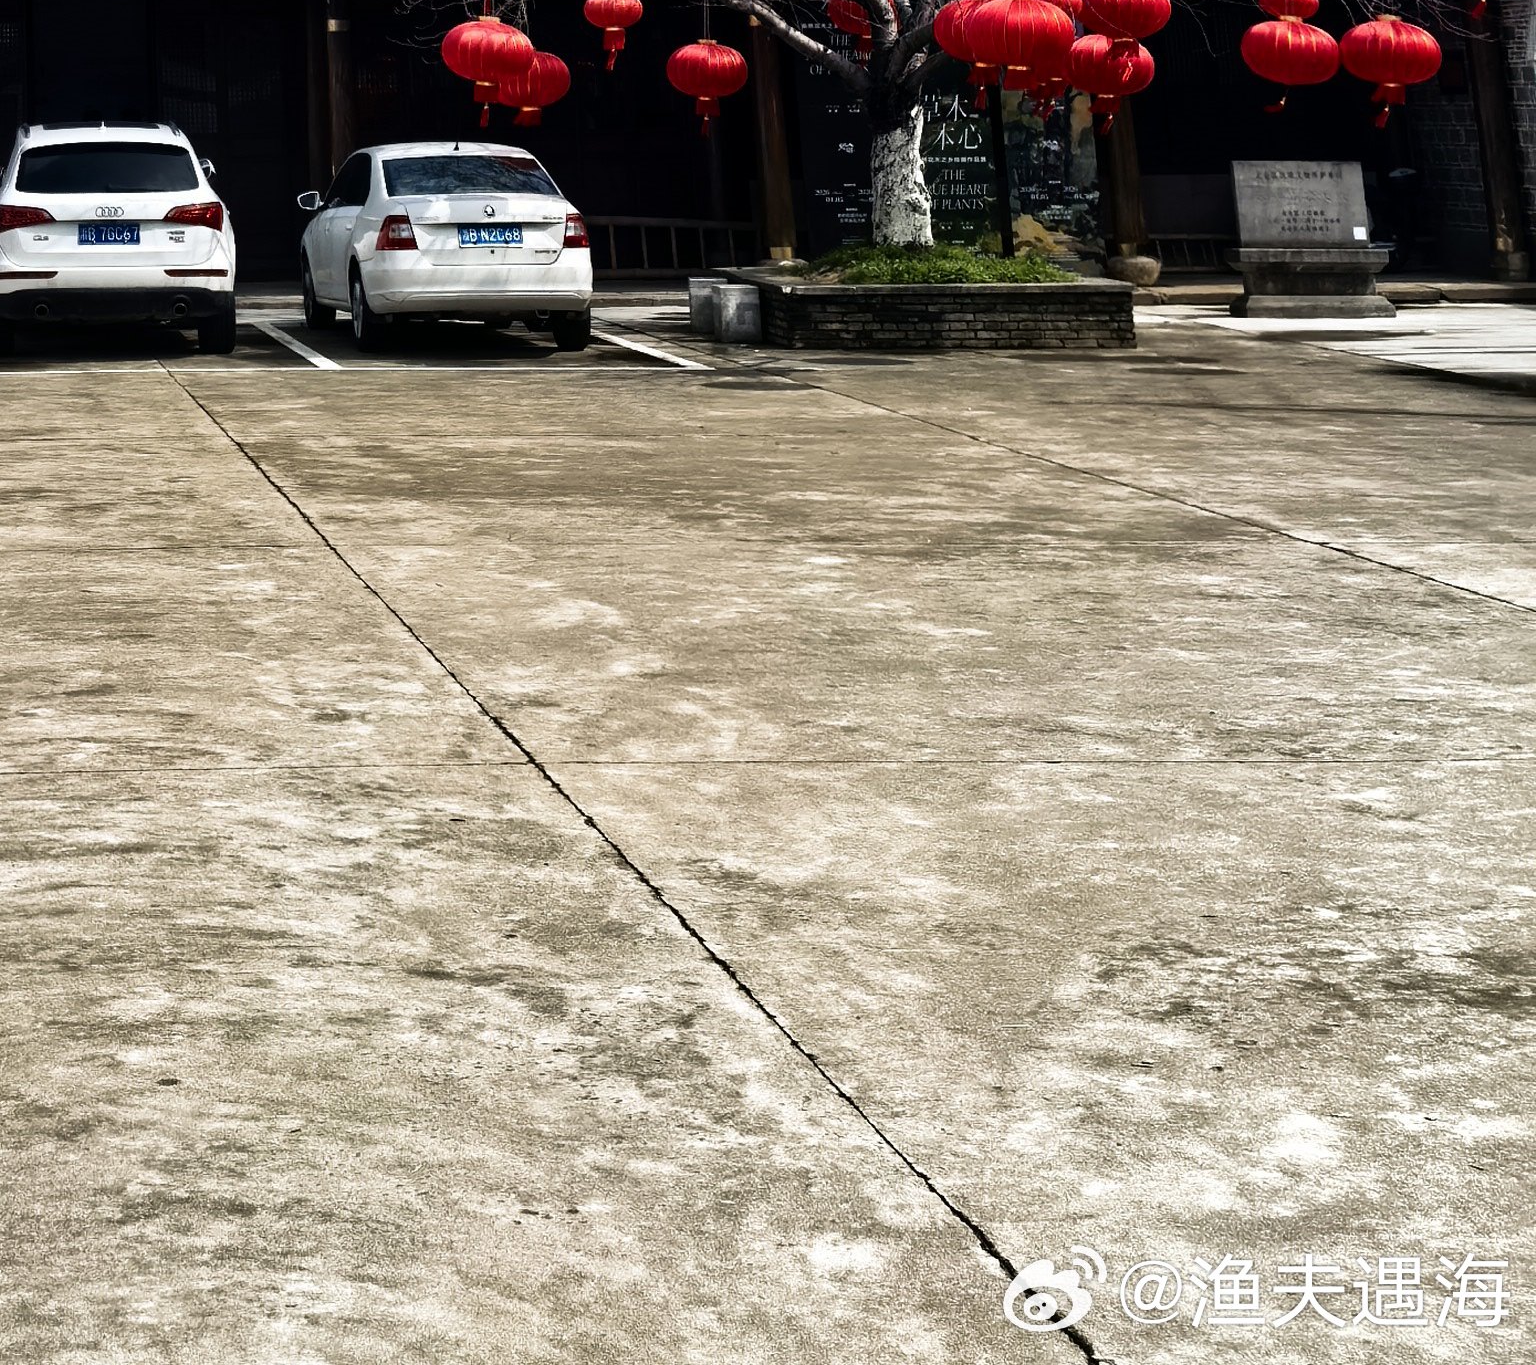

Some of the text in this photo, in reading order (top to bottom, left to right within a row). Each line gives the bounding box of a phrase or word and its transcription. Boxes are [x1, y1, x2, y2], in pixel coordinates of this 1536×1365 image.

[923, 94, 968, 122] 草木
[942, 169, 966, 181] THE
[950, 183, 990, 195] HEART
[942, 198, 985, 211] PLANTS
